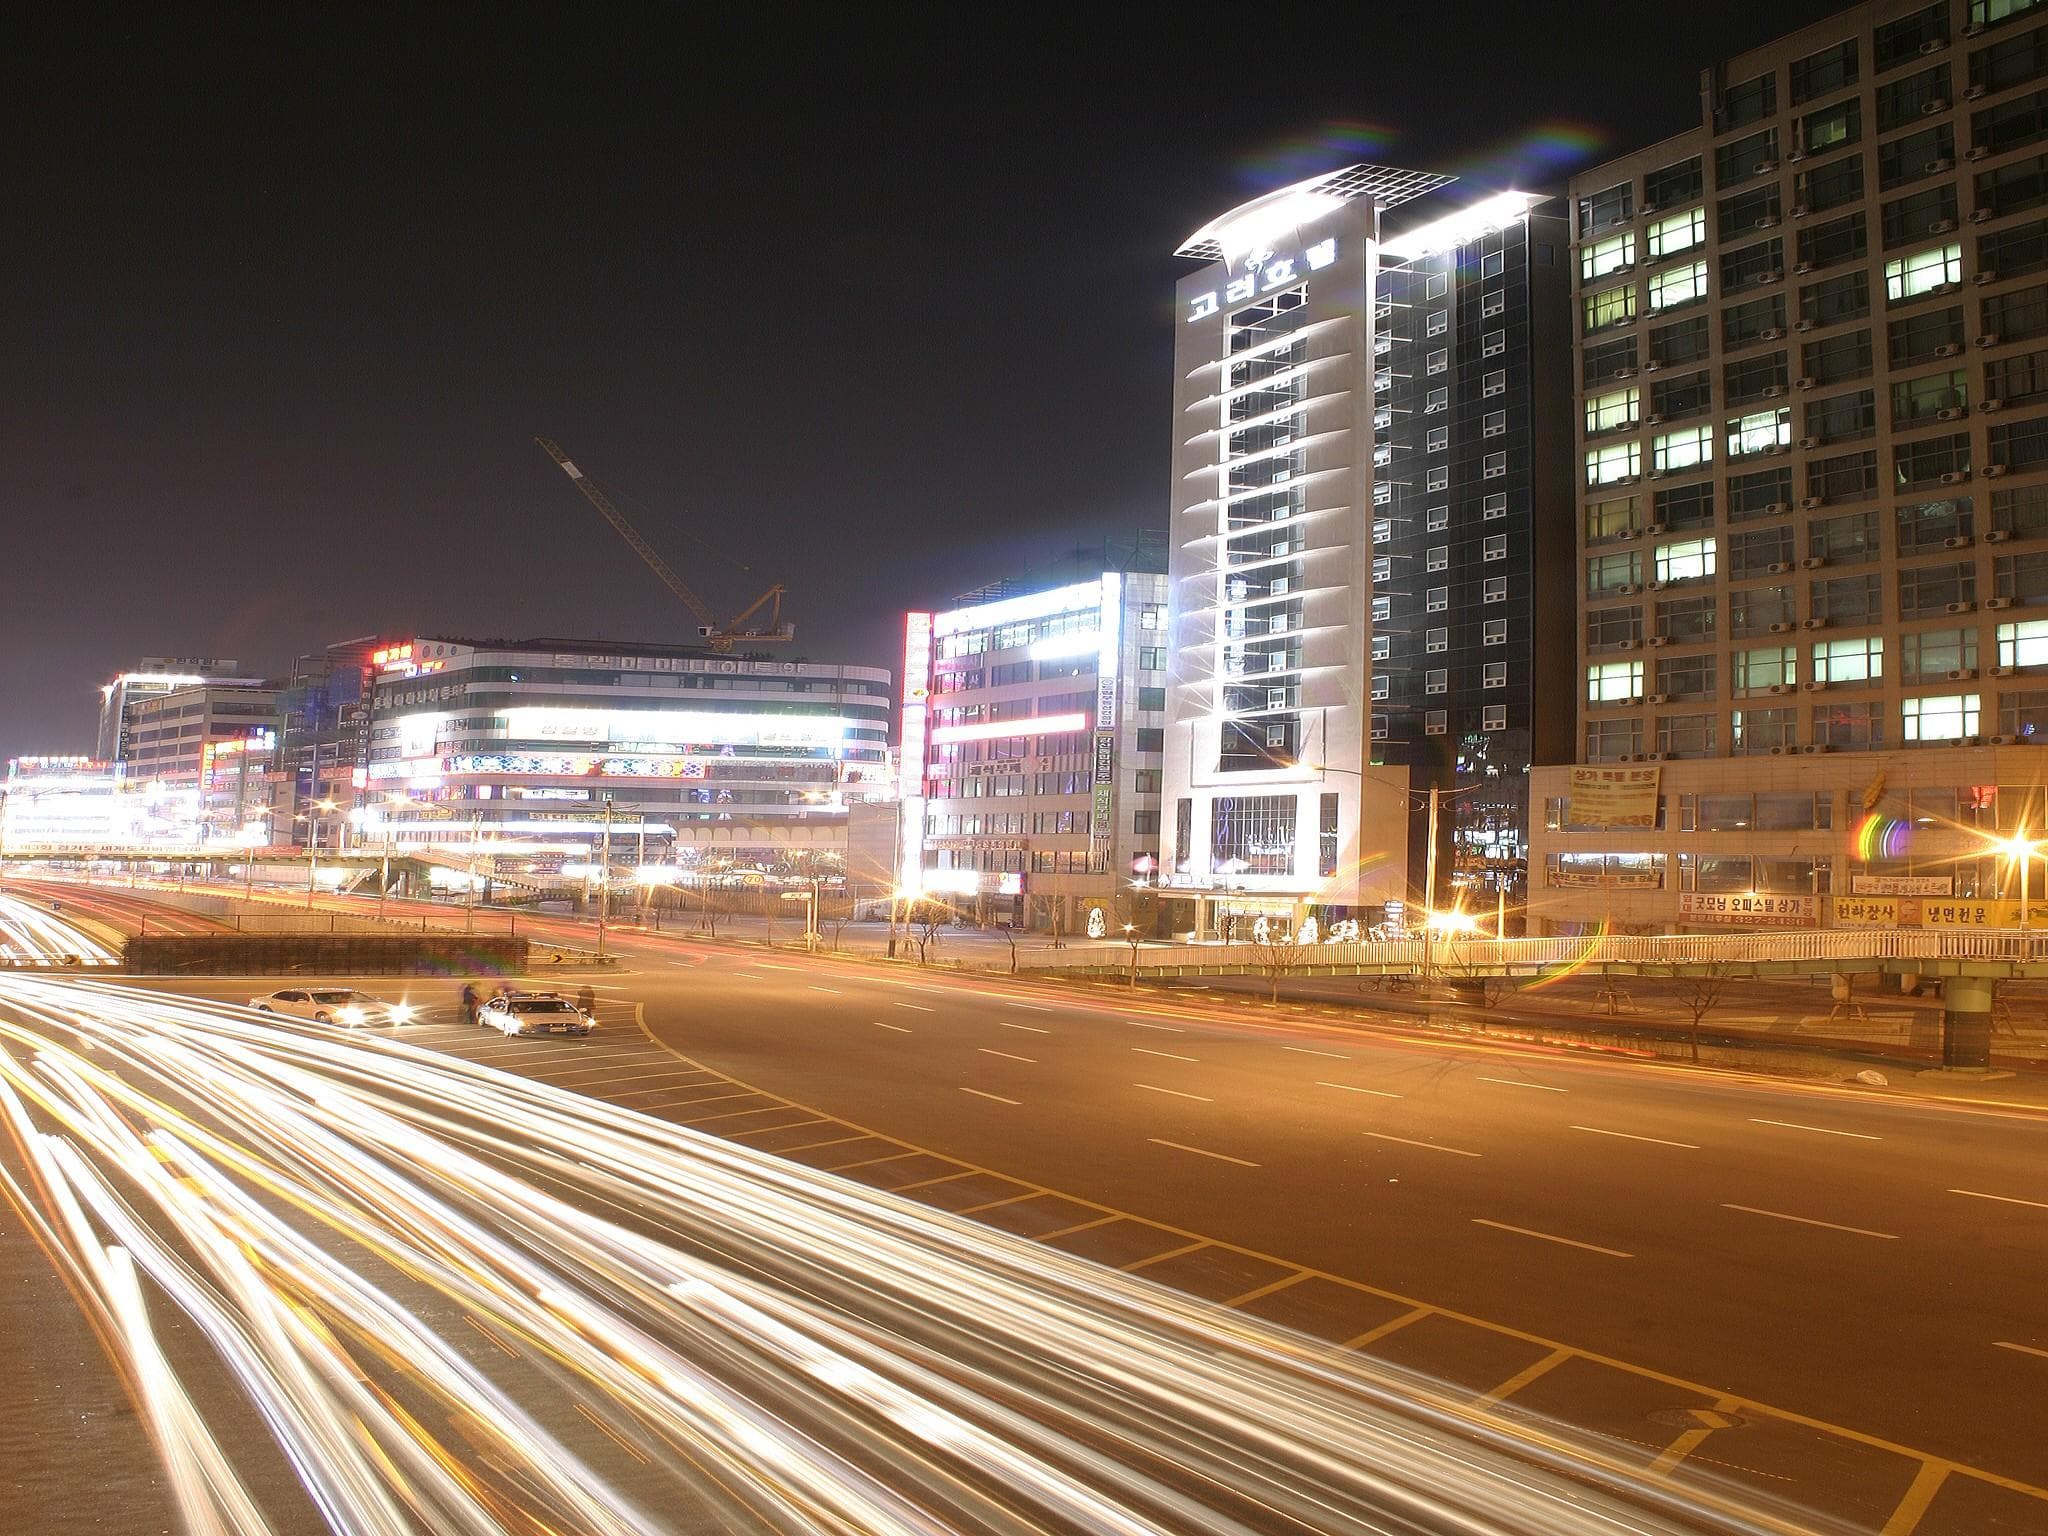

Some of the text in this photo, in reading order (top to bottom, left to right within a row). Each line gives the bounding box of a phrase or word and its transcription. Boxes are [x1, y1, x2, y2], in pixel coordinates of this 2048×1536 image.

[1695, 896, 1801, 914] 굿모닝 오피스텔 상가
[1837, 903, 1895, 921] 천하장사
[1928, 906, 1986, 924] 냉면전문
